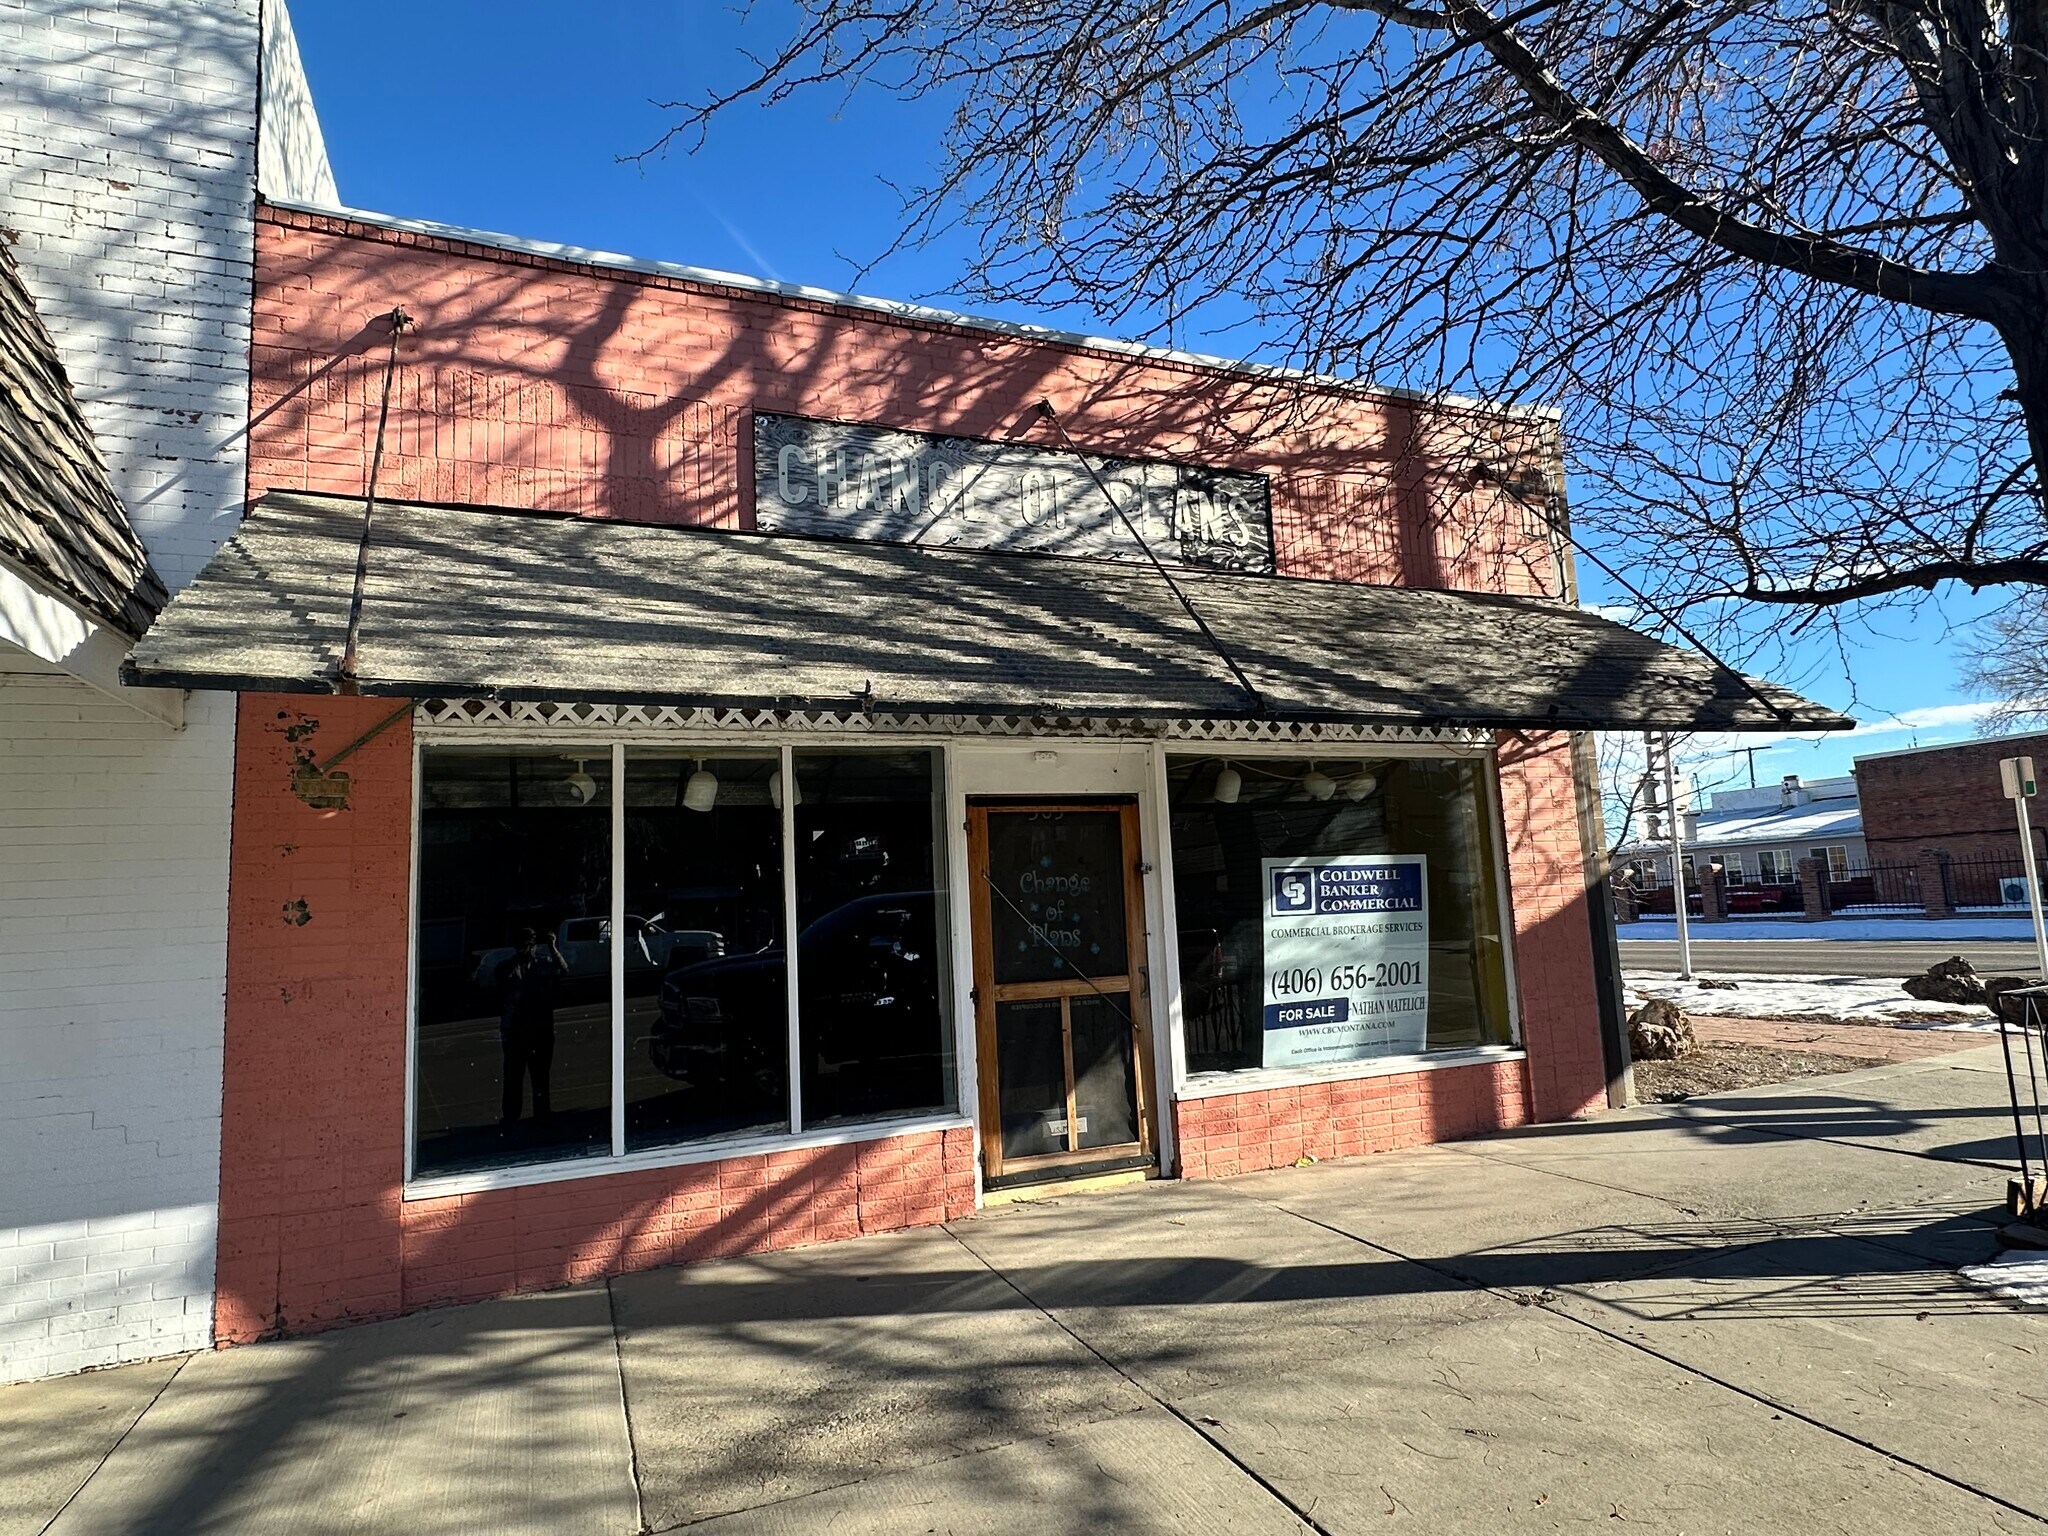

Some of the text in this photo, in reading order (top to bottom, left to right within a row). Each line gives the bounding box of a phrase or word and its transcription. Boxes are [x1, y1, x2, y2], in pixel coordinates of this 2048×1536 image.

[778, 444, 988, 524] CHANGE
[1109, 481, 1251, 547] PLANS
[1020, 870, 1090, 896] Change
[1319, 869, 1401, 882] COLDWELL
[1320, 884, 1379, 897] BANKER
[1320, 897, 1418, 912] COMMERCIAL
[1028, 923, 1081, 948] Plans
[1271, 922, 1423, 939] COMMERCIAL BROKERAGE SERVICES
[1271, 961, 1423, 999] (406) 656-2001
[1278, 1005, 1336, 1023] FOR SALE
[1352, 996, 1425, 1015] NATHAN MATELICH
[1299, 1020, 1396, 1037] WWW.CBCMONTANA.COM
